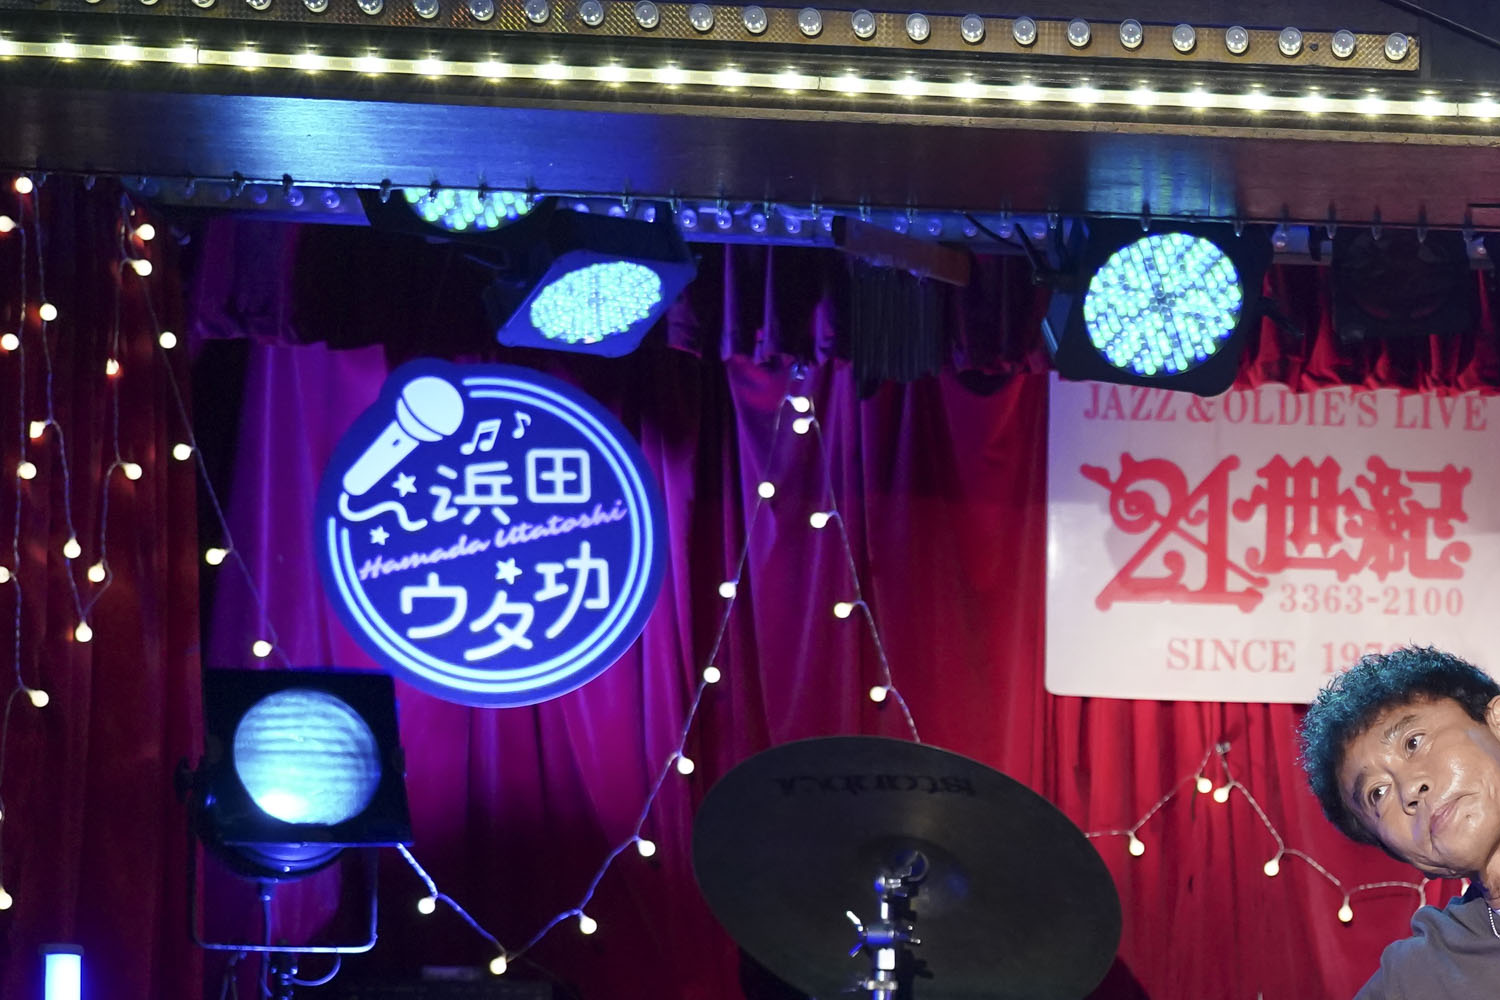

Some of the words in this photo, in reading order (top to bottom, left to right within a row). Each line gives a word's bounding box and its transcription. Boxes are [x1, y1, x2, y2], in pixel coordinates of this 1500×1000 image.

[1083, 384, 1176, 422] JAZZ
[1186, 396, 1216, 423] &
[1224, 388, 1377, 428] OLDIE'S
[1394, 394, 1488, 431] LIVE
[429, 448, 591, 525] 浜田
[359, 533, 491, 581] Hamada
[494, 498, 628, 549] Utatoshi
[1080, 452, 1473, 614] 21世紀
[400, 541, 610, 660] ウタ功
[1279, 582, 1464, 617] 3363-2100
[1166, 637, 1296, 674] SINCE
